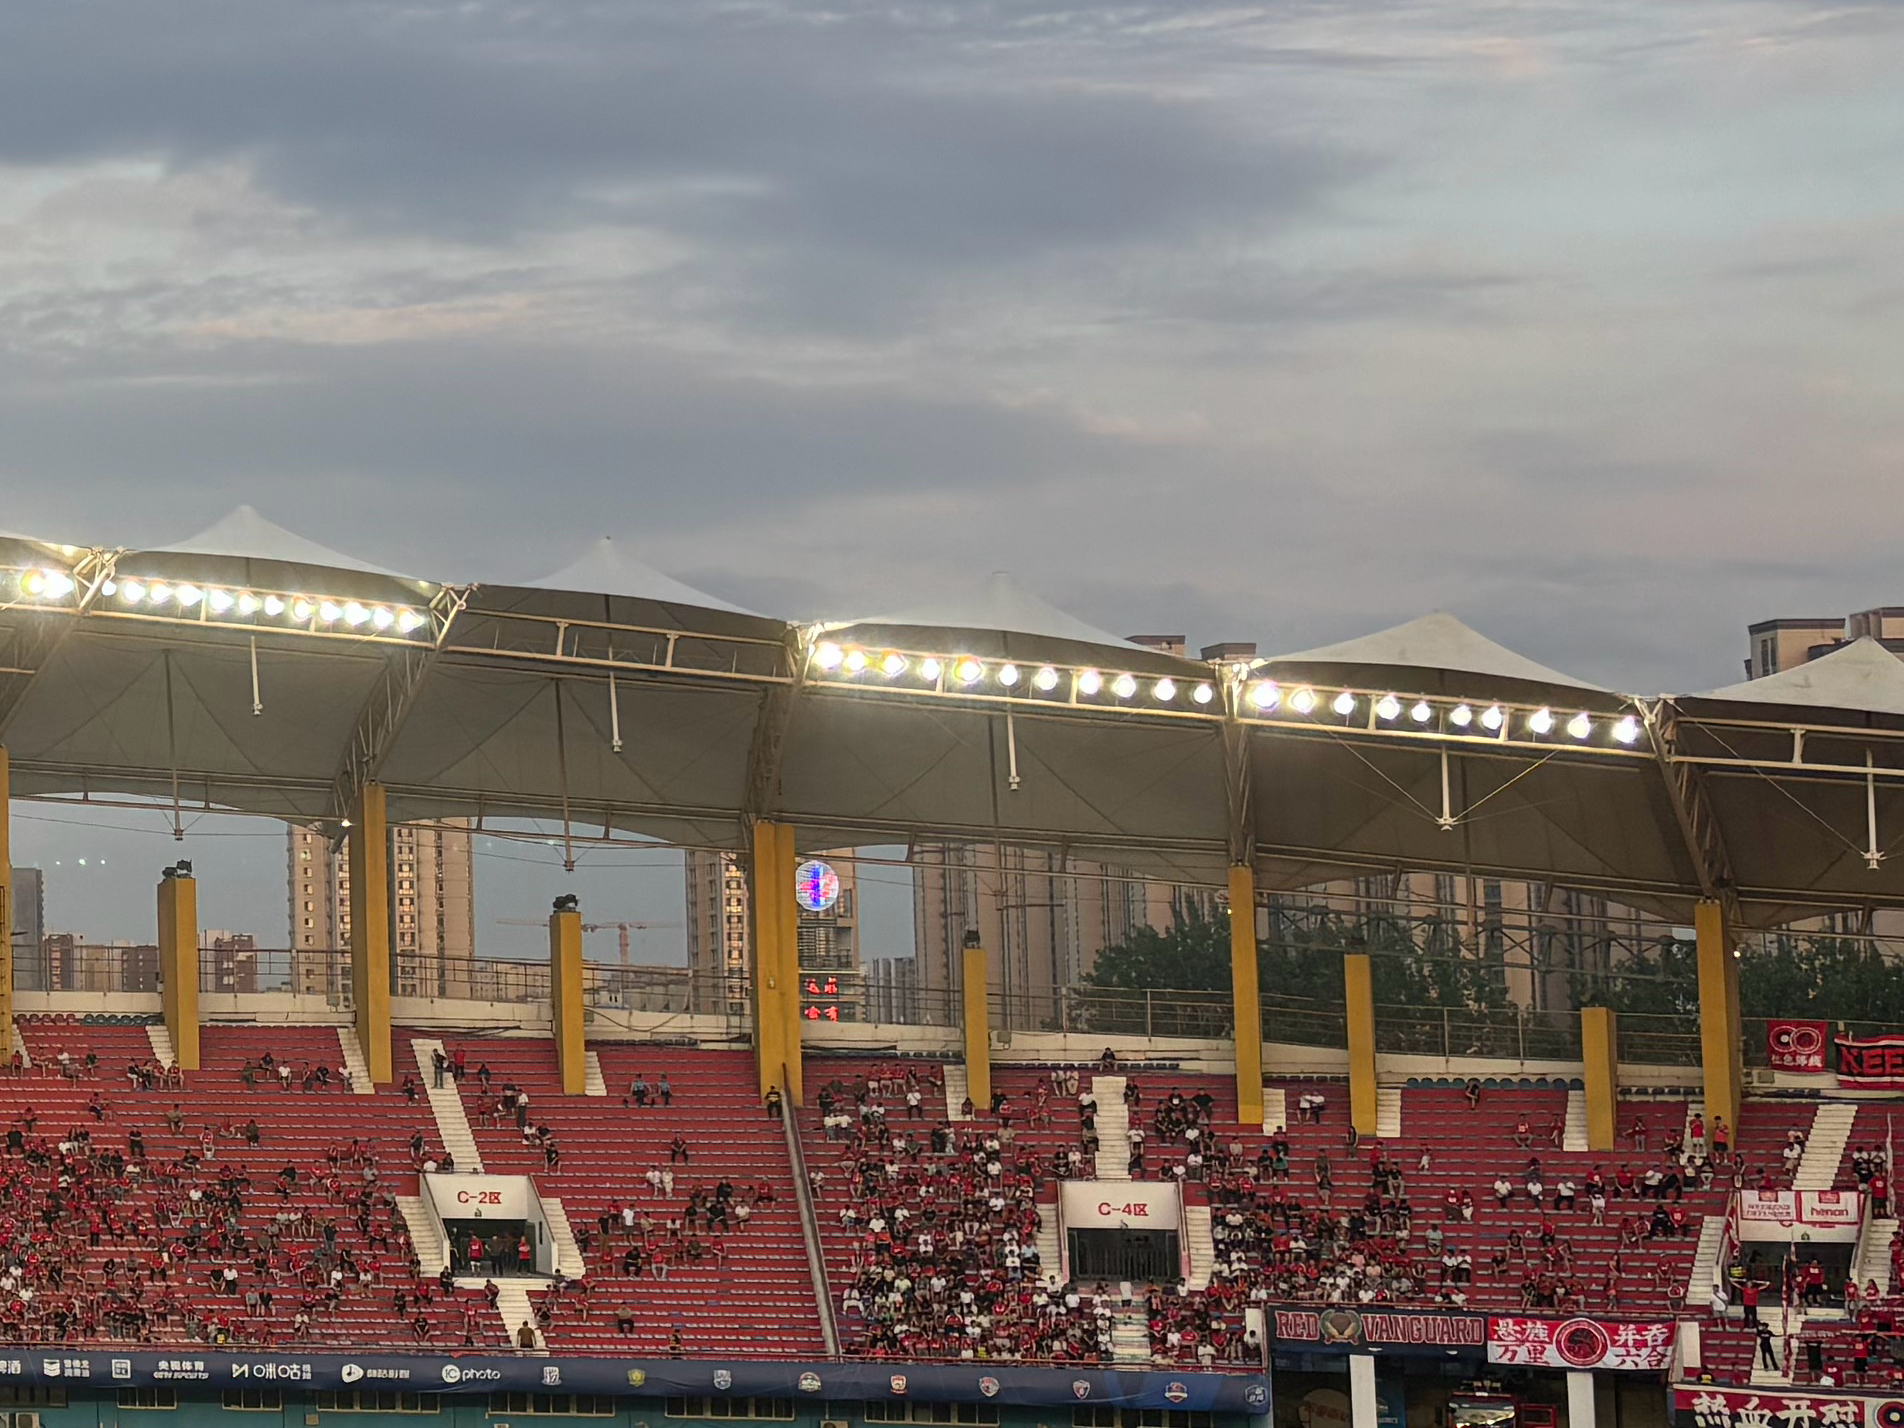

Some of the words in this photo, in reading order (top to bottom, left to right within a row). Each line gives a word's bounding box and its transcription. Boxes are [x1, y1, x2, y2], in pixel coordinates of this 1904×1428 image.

[457, 1191, 502, 1204] C-2区
[1098, 1202, 1149, 1216] C-4区
[1275, 1310, 1320, 1340] RED
[1361, 1313, 1485, 1345] VANGUARD
[462, 1368, 501, 1381] photo
